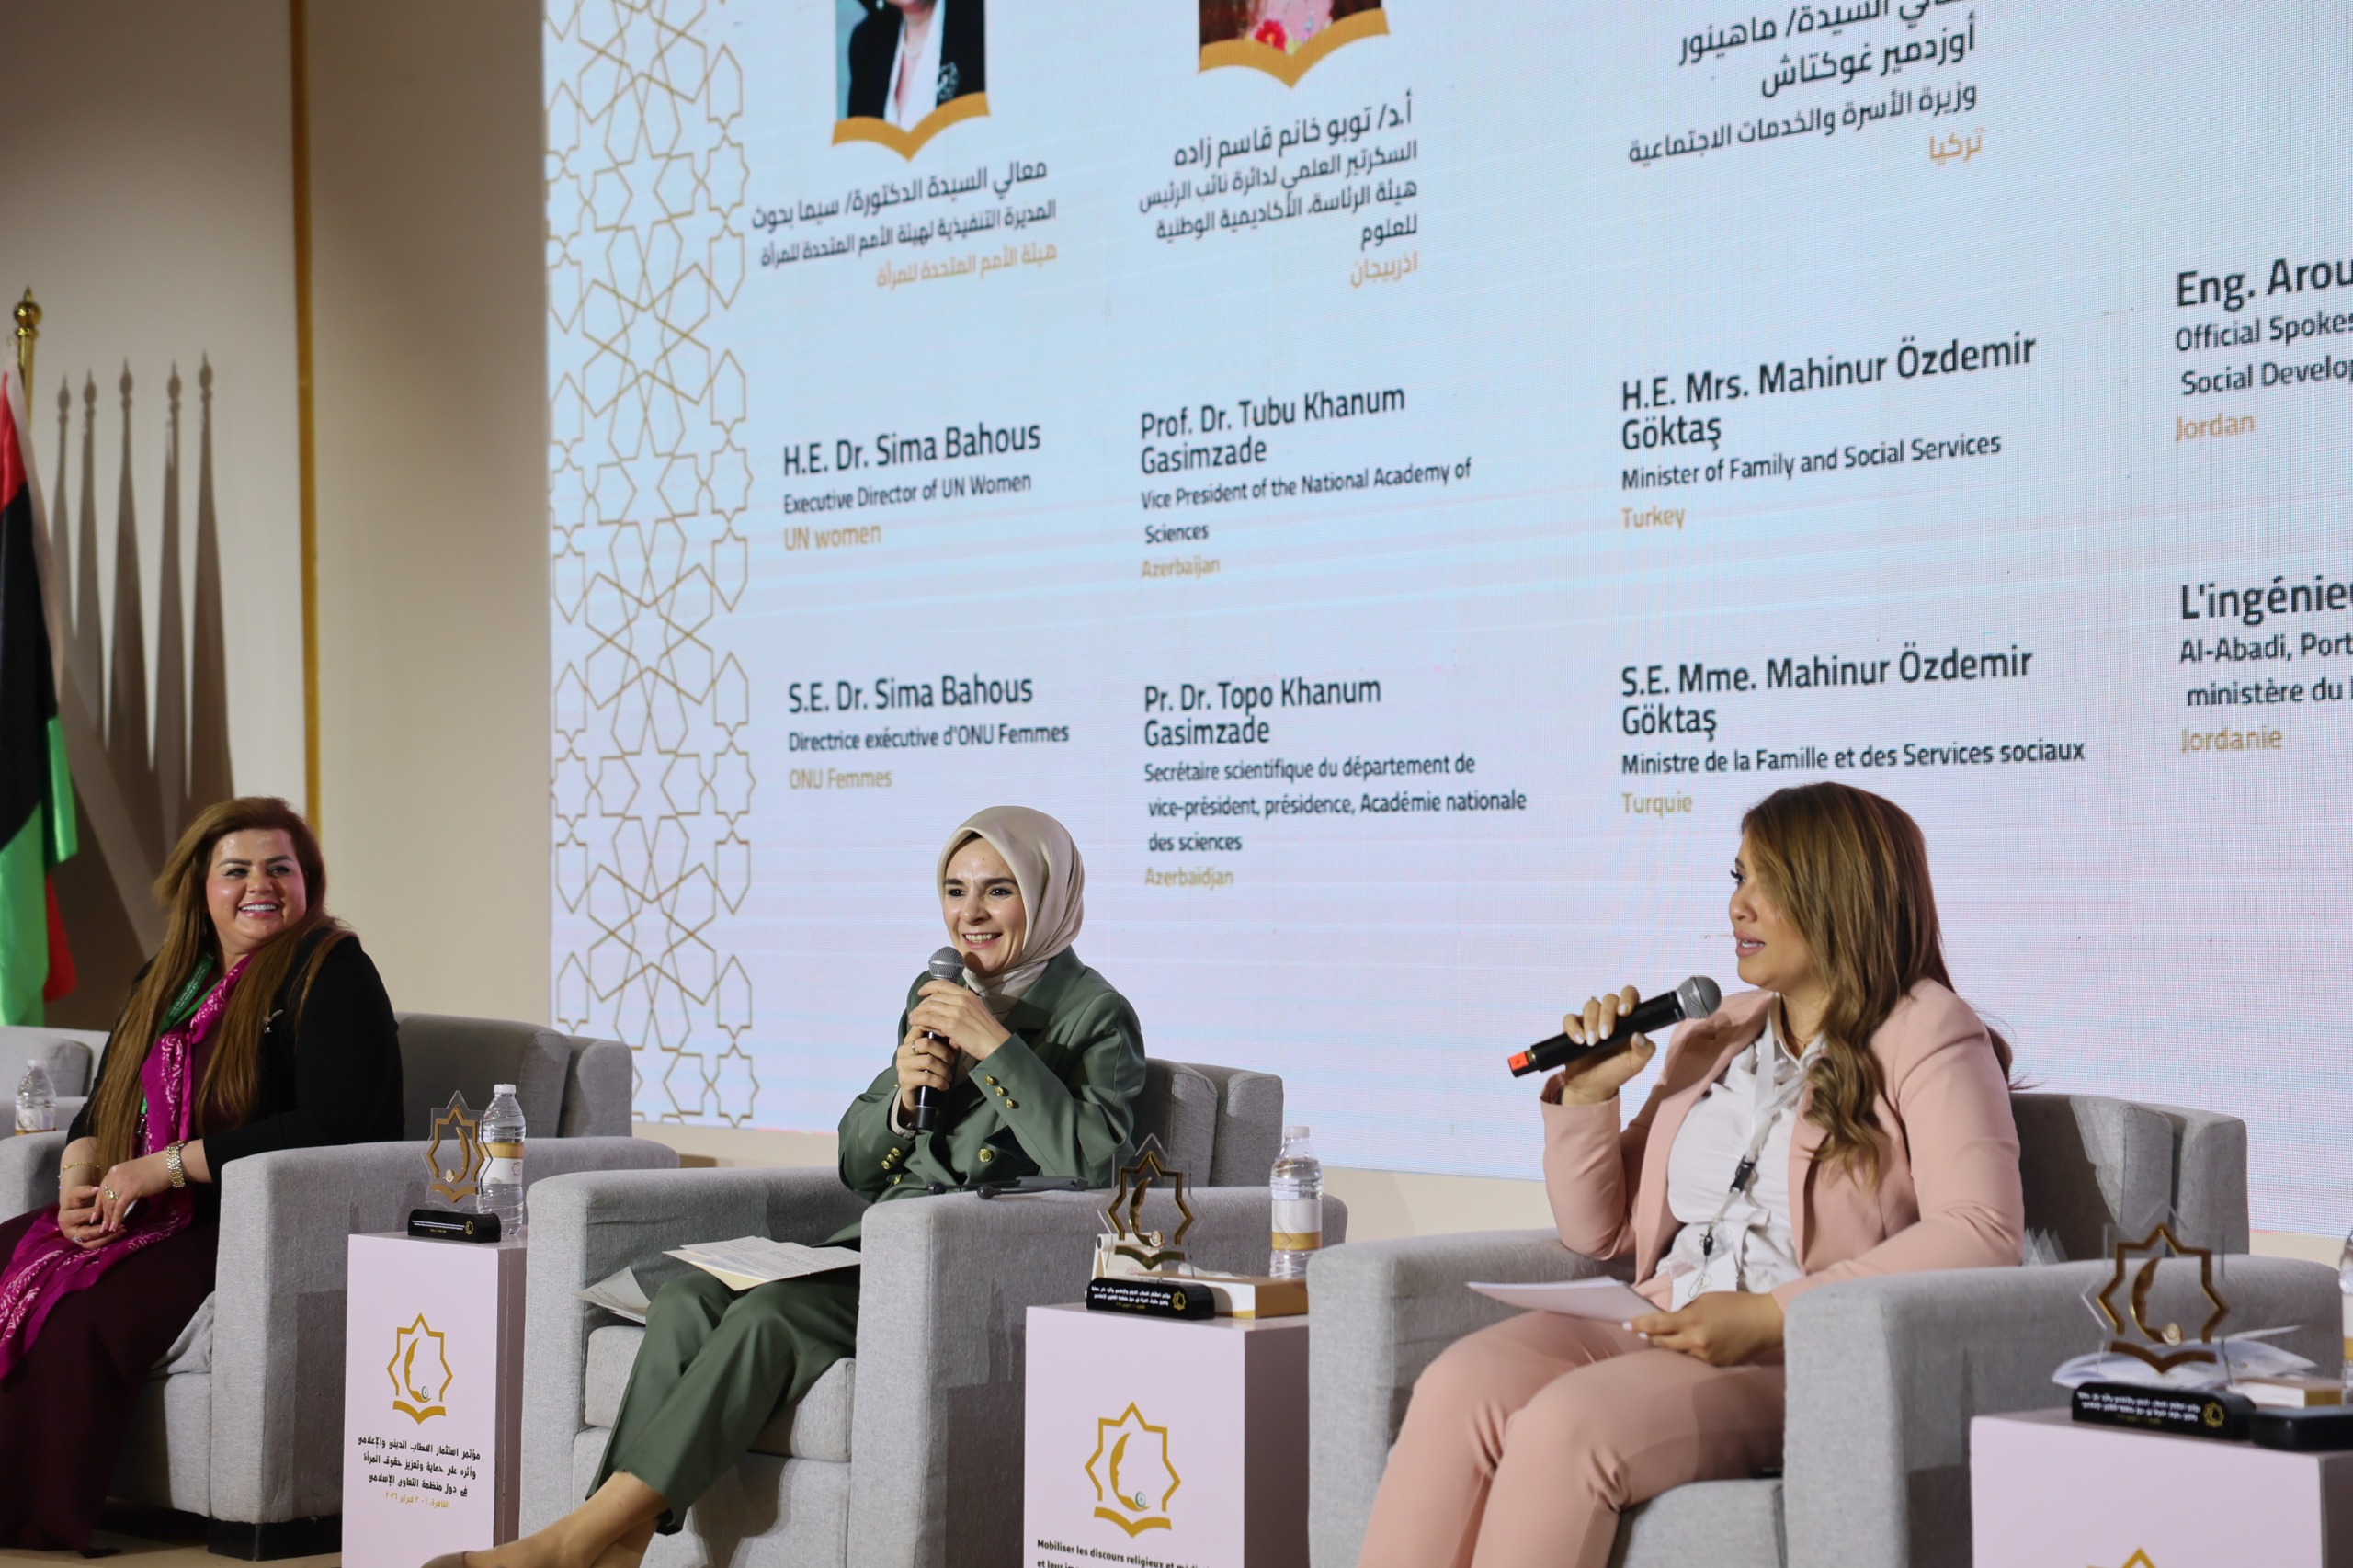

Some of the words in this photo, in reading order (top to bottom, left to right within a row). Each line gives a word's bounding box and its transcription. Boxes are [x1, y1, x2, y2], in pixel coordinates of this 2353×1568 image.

[1679, 16, 1777, 66] ماهينور
[1881, 13, 1976, 76] أوزدمير
[1762, 43, 1872, 97] غوكتاش
[1843, 90, 1912, 131] الأسرة
[1919, 84, 1977, 116] وزيرة
[1279, 117, 1321, 157] خانم
[1327, 107, 1371, 145] توبو
[1738, 106, 1836, 143] والخدمات
[1175, 137, 1211, 167] زاده
[1218, 126, 1272, 167] قاسم
[1346, 140, 1417, 176] السكرتير
[1629, 123, 1732, 165] الاجتماعية
[1929, 127, 1984, 164] تركيا
[928, 167, 987, 201] السيدة
[993, 160, 1047, 200] معالي
[1233, 165, 1277, 196] لدائرة
[1282, 154, 1341, 189] العلمي
[1140, 181, 1191, 213] الرئيس
[1195, 174, 1227, 202] نائب
[1376, 179, 1417, 206] هيئة
[752, 205, 794, 233] بحوث
[799, 198, 839, 224] سيما
[938, 210, 1001, 239] التنفيذية
[1005, 199, 1056, 228] المديرة
[1156, 211, 1214, 243] الوطنية
[1220, 192, 1302, 233] الأكاديمية
[858, 227, 893, 257] الأمم
[898, 222, 934, 248] لهيئة
[1360, 213, 1417, 250] للعلوم
[761, 242, 799, 268] للمرأة
[803, 236, 855, 260] المتحدة
[982, 247, 1017, 278] الأمم
[1022, 241, 1056, 267] هيئة
[877, 262, 917, 291] للمرأة
[921, 254, 976, 280] المتحدة
[2177, 270, 2255, 312] Eng.
[2177, 318, 2260, 351] Official
[1622, 376, 1676, 410] H.E.
[1687, 371, 1748, 403] Mrs.
[1759, 354, 1887, 395] Mahinur
[1897, 332, 2037, 379] Özdemir
[2181, 364, 2253, 396] Social
[1142, 406, 1192, 439] Prof.
[1201, 404, 1232, 434] Dr.
[1239, 396, 1295, 428] Tubu
[1304, 387, 1404, 422] Khanum
[2177, 413, 2256, 441] Jordan
[784, 442, 828, 475] H.E.
[837, 439, 869, 470] Dr.
[877, 432, 936, 466] Sima
[946, 422, 1040, 459] Bahous
[1622, 415, 1722, 451] Göktaş
[1142, 435, 1267, 474] Gasimzade
[1621, 460, 1699, 490] Minister
[1706, 458, 1724, 482] of
[1729, 453, 1794, 480] Family
[1801, 448, 1837, 472] and
[1844, 439, 1904, 468] Social
[1911, 432, 2002, 461] Services
[784, 490, 853, 514] Executive
[858, 484, 917, 508] Director
[923, 479, 938, 501] of
[942, 477, 965, 499] UN
[970, 473, 1031, 496] Women
[1141, 488, 1171, 509] Vice
[1176, 482, 1248, 506] President
[1252, 477, 1267, 497] of
[1272, 476, 1296, 497] the
[1302, 468, 1369, 494] National
[1374, 463, 1449, 487] Academy
[1454, 457, 1472, 480] of
[1145, 523, 1209, 544] Sciences
[1621, 506, 1687, 530] Turkey
[784, 527, 810, 551] UN
[815, 525, 881, 549] women
[1142, 555, 1221, 579] Azerbaijan
[2182, 575, 2353, 626] L'ingénie
[2180, 633, 2292, 664] Al-Abadi,
[1621, 665, 1670, 697] S.E.
[1680, 663, 1757, 693] Mme.
[1768, 655, 1891, 689] Mahinur
[1900, 642, 2033, 683] Özdemir
[789, 682, 829, 713] S.E.
[837, 680, 868, 710] Dr.
[876, 677, 934, 710] Sima
[941, 673, 1033, 706] Bahous
[1144, 685, 1173, 712] Pr.
[1181, 683, 1211, 710] Dr.
[1218, 681, 1273, 715] Topo
[1281, 677, 1381, 707] Khanum
[2188, 677, 2304, 706] ministère
[2312, 677, 2343, 701] du
[789, 729, 860, 752] Directrice
[865, 726, 939, 749] exécutive
[943, 725, 995, 745] d'ONU
[999, 722, 1070, 744] Femmes
[1144, 715, 1270, 747] Gasimzade
[1622, 702, 1718, 741] Göktaş
[2181, 725, 2283, 754] Jordanie
[1144, 759, 1219, 782] Secrétaire
[1223, 757, 1314, 783] scientifique
[1318, 756, 1337, 778] du
[1343, 754, 1450, 781] département
[1455, 753, 1475, 775] de
[1621, 750, 1699, 775] Ministre
[1704, 749, 1728, 772] de
[1734, 749, 1751, 771] la
[1756, 744, 1829, 770] Famille
[1835, 747, 1855, 767] et
[1860, 744, 1898, 767] des
[1904, 741, 1994, 767] Services
[2000, 737, 2086, 763] sociaux
[790, 768, 824, 790] ONU
[828, 767, 892, 789] Femmes
[1148, 794, 1260, 820] vice-président,
[1265, 792, 1356, 820] présidence,
[1360, 790, 1441, 812] Académie
[1446, 789, 1527, 812] nationale
[1621, 790, 1693, 819] Turquie
[1149, 833, 1174, 852] des
[1178, 831, 1243, 852] sciences
[461, 1449, 480, 1461] مؤتمر
[1037, 1539, 1074, 1554] Mobiliser
[1076, 1546, 1088, 1556] les
[1090, 1548, 1124, 1562] discours
[1127, 1556, 1164, 1568] religieux
